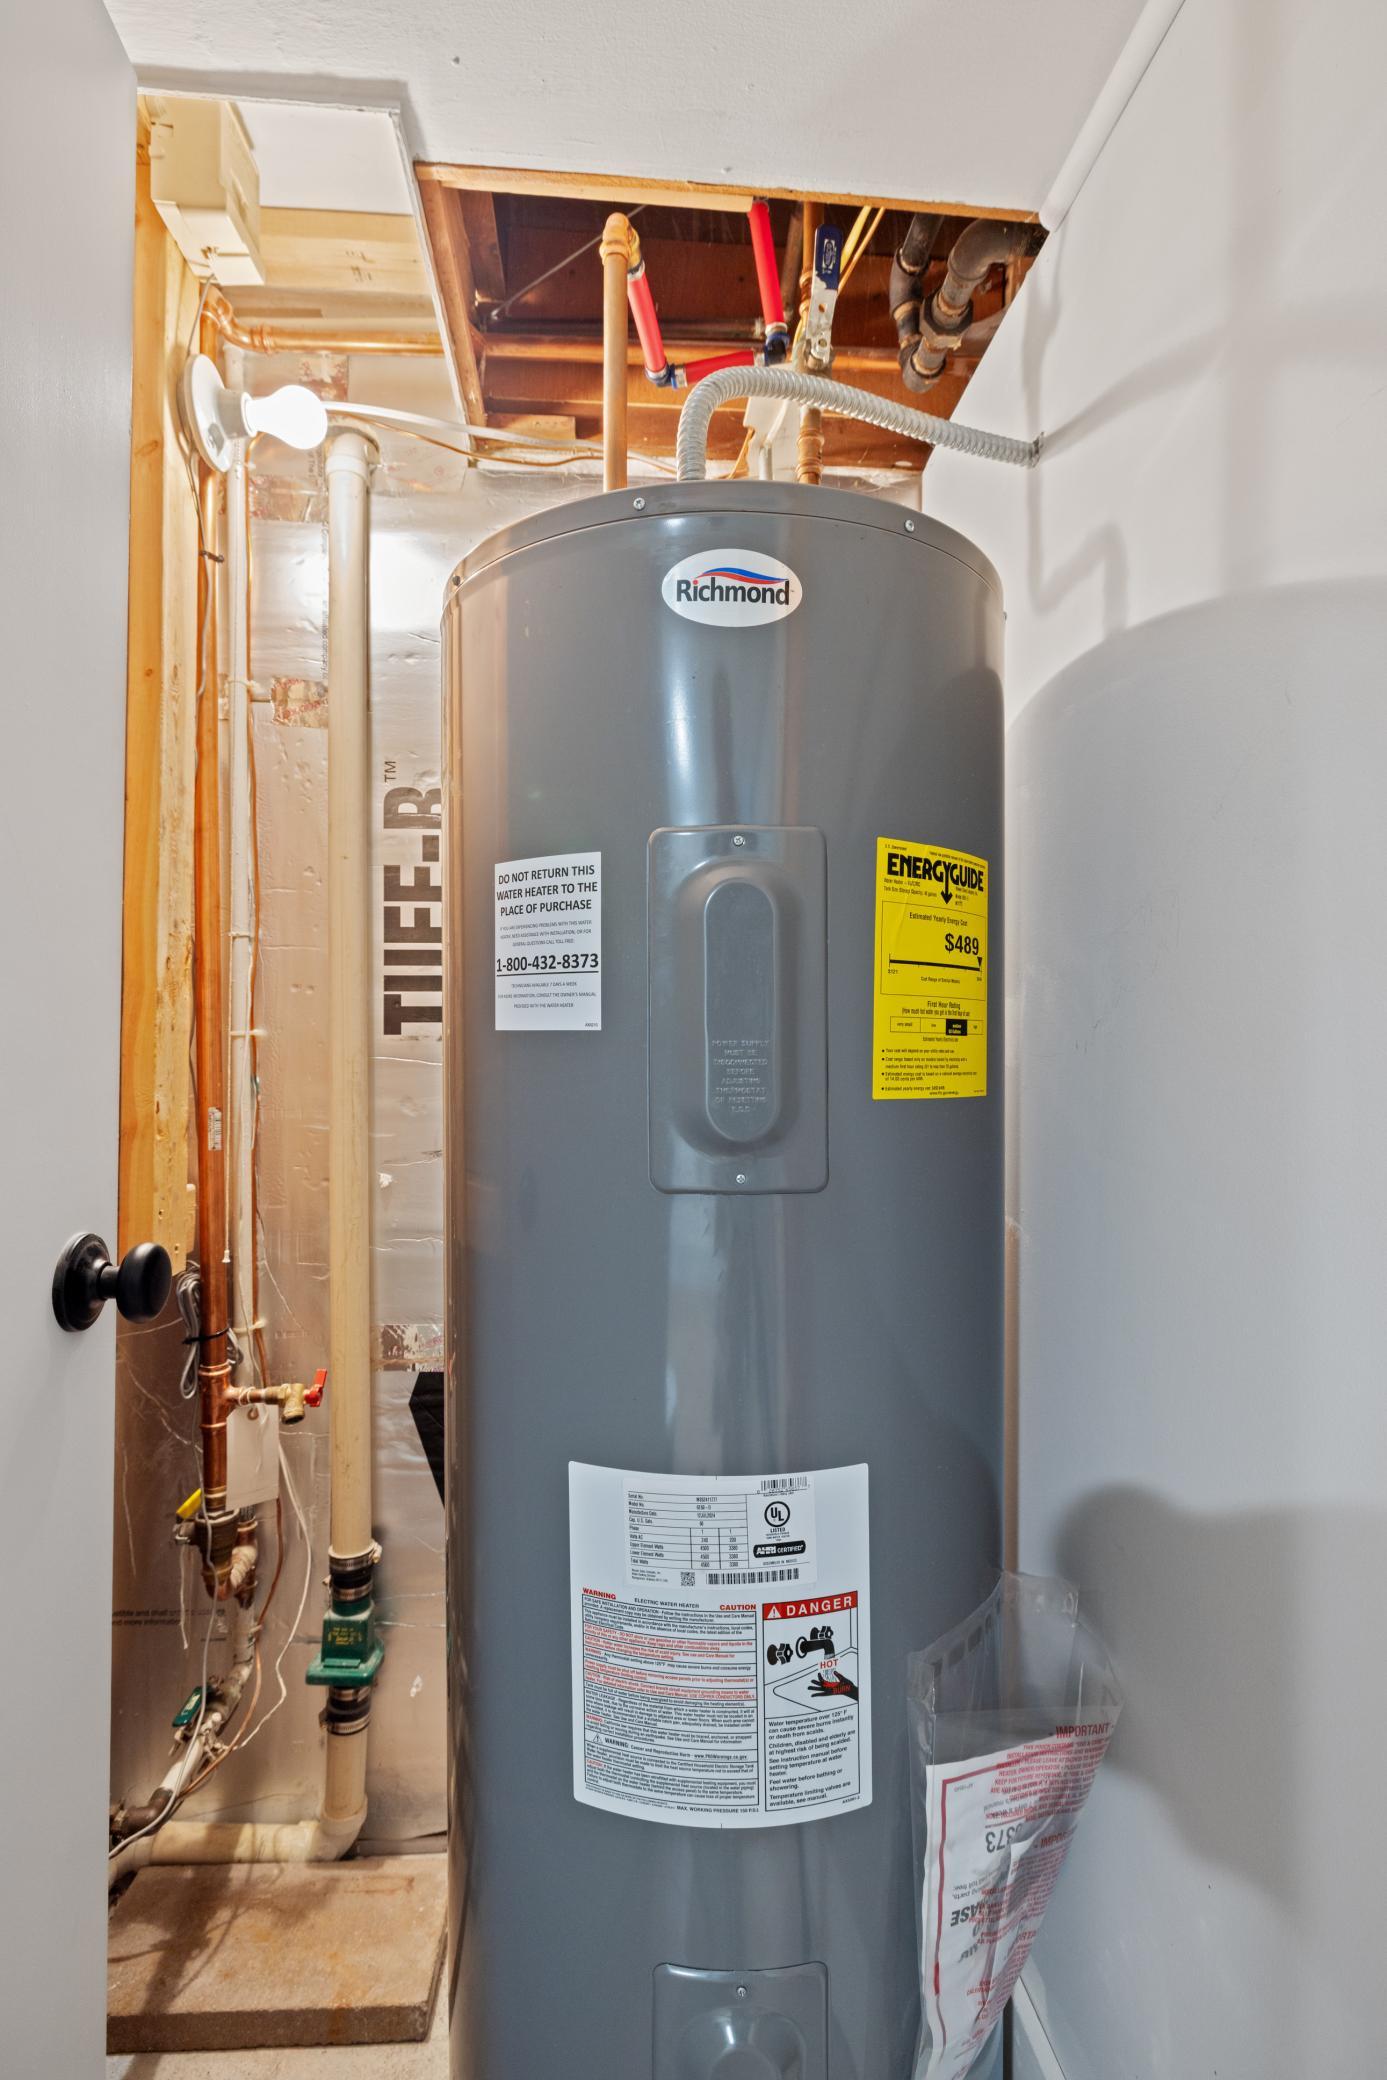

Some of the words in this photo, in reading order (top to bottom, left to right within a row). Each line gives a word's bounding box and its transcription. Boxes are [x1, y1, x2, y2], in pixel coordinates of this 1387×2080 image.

[677, 578, 789, 605] Richmond
[499, 874, 509, 884] DO
[512, 872, 529, 882] NOT
[532, 867, 568, 880] RETURN
[572, 865, 595, 876] THIS
[888, 852, 983, 892] ENERGYGUIDE
[497, 889, 522, 900] WATER
[525, 885, 558, 897] HEATER
[561, 884, 574, 894] TO
[578, 882, 598, 892] THE
[501, 905, 523, 916] PLACE
[526, 904, 537, 913] OF
[540, 900, 591, 912] PURCHASE
[910, 912, 932, 920] Estimated
[933, 915, 946, 924] Yearly
[945, 933, 979, 955] $489
[497, 954, 598, 972] 1-800-432-8373
[770, 1507, 784, 1521] UL
[583, 1588, 616, 1599] WARNING
[786, 1596, 851, 1616] DANGER
[820, 1659, 838, 1669] HOT
[785, 1716, 818, 1726] temperature
[1056, 1723, 1109, 1738] IMPORTANT
